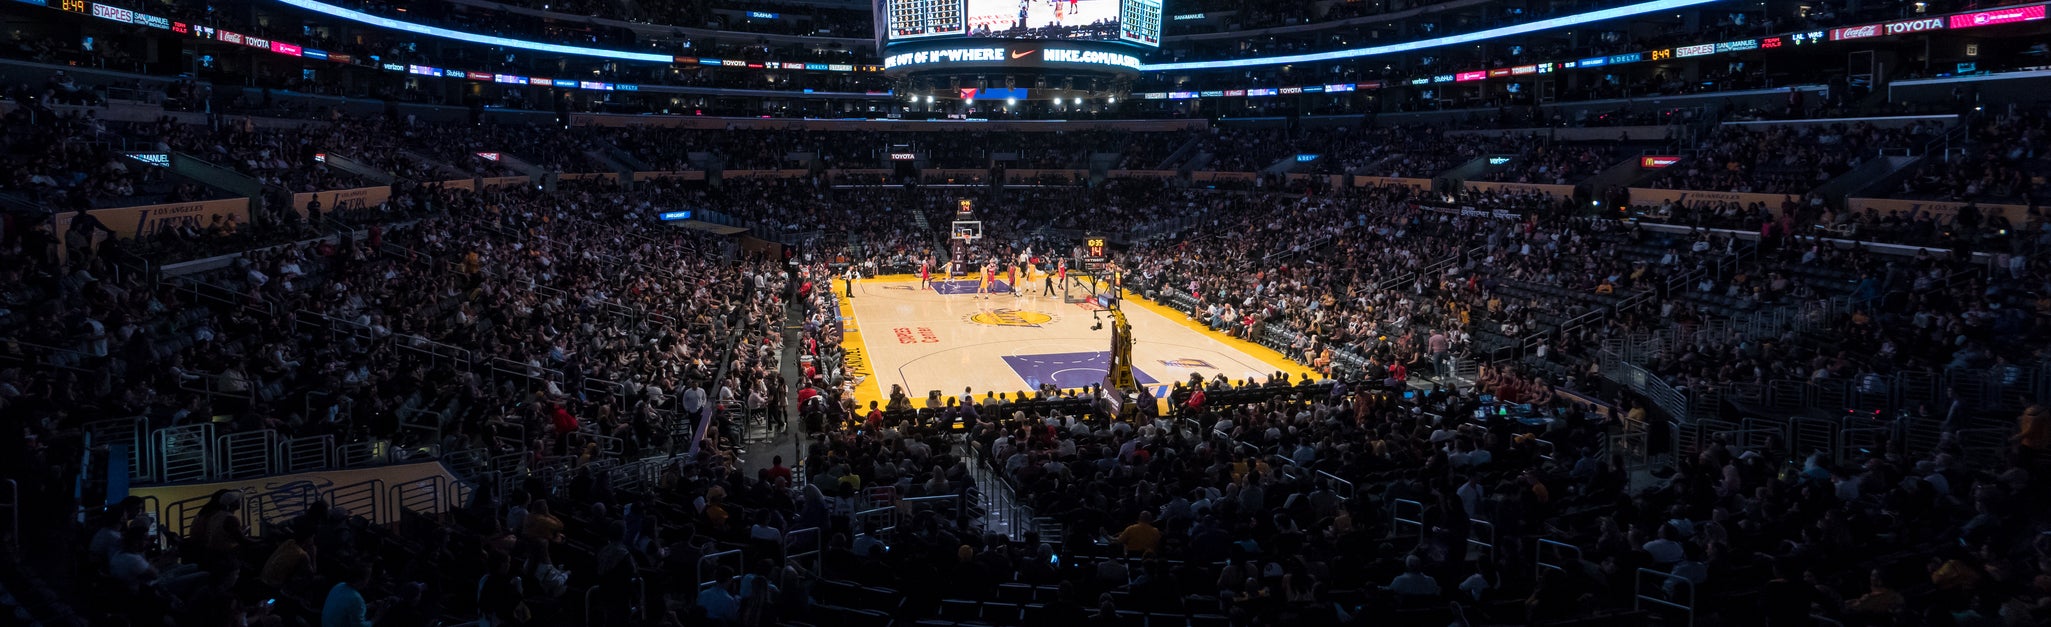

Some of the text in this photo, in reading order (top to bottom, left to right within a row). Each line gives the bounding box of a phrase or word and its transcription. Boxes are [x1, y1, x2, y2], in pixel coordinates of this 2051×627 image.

[62, 0, 84, 12] 8:49
[94, 4, 132, 22] STAPLES
[1885, 17, 1943, 34] TOYOTA
[1844, 25, 1876, 39] Coca-Cola
[245, 36, 269, 48] TOYOTA
[1732, 39, 1757, 47] MANUEL
[1652, 49, 1670, 61] 8:49
[1677, 45, 1713, 57] STAPLES
[897, 53, 913, 66] OUT
[914, 51, 929, 64] OF
[1616, 54, 1640, 63] DELTA
[384, 63, 404, 72] verizon
[446, 69, 465, 78] StubHub
[1434, 75, 1453, 83] StubHub
[168, 205, 204, 214] ANGELES
[1091, 246, 1102, 256] 14
